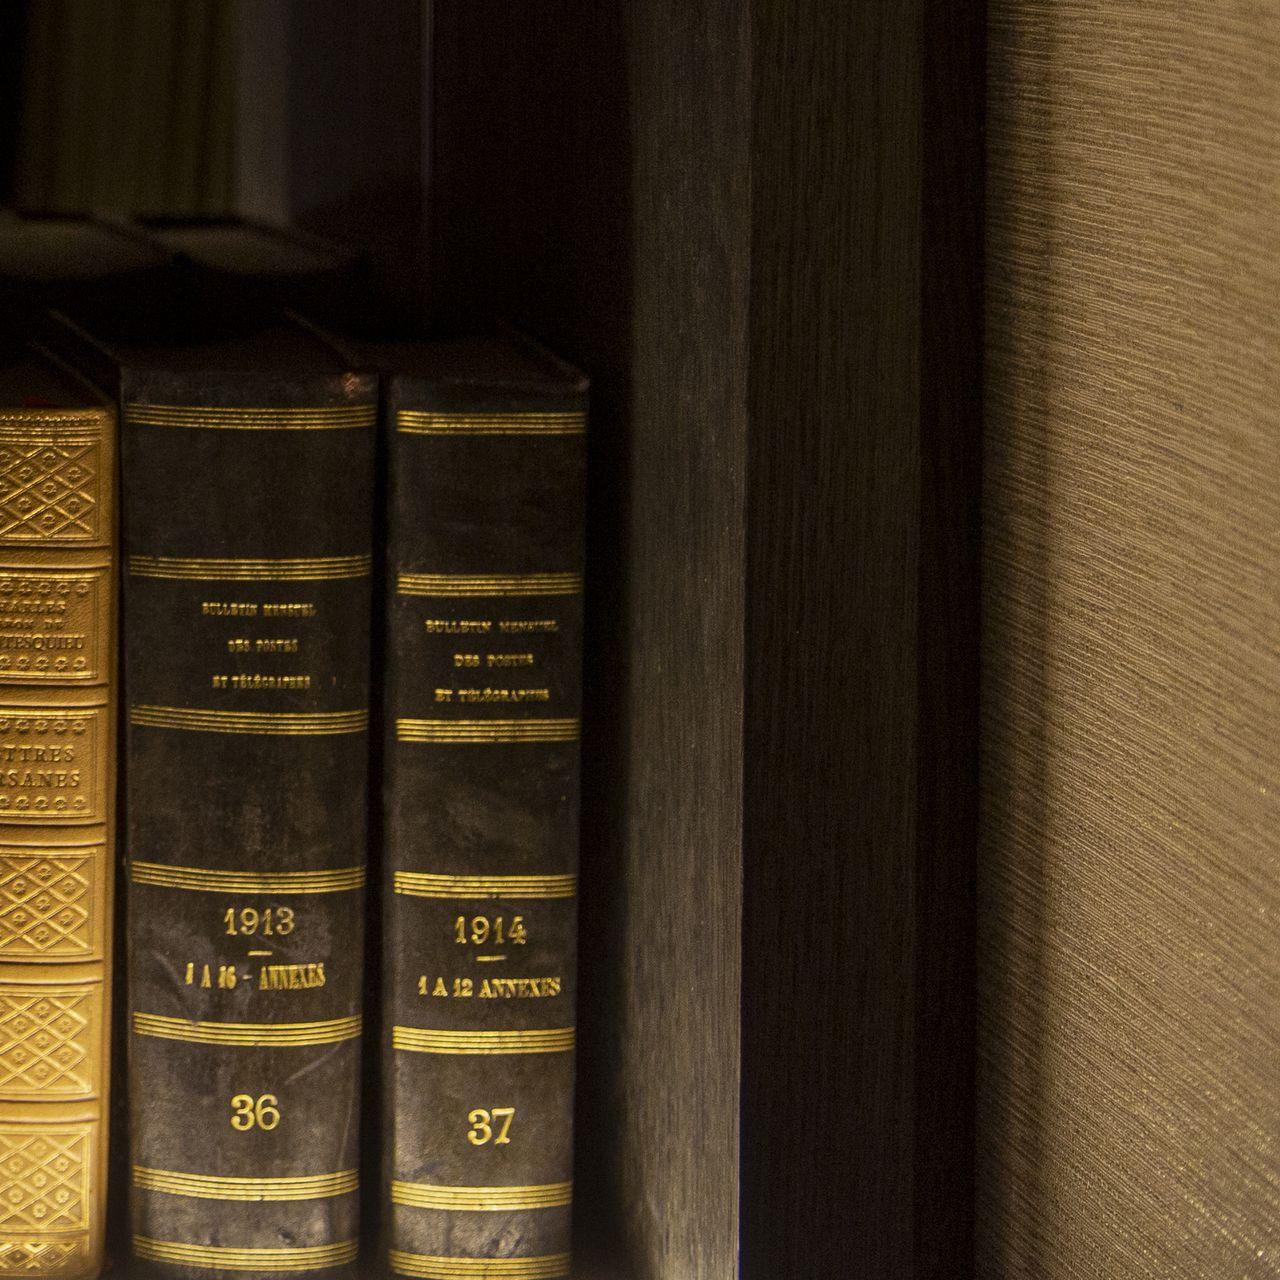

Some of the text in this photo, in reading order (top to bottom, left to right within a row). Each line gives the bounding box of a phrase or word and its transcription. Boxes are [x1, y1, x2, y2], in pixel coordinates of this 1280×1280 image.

[223, 907, 295, 936] 1913
[454, 915, 528, 946] 1914
[200, 964, 212, 989] A
[258, 962, 327, 991] ANNEXES
[432, 976, 448, 997] A
[453, 977, 474, 997] 12
[478, 975, 561, 999] ANNEXES
[230, 1093, 281, 1131] 36
[467, 1106, 516, 1146] 37
